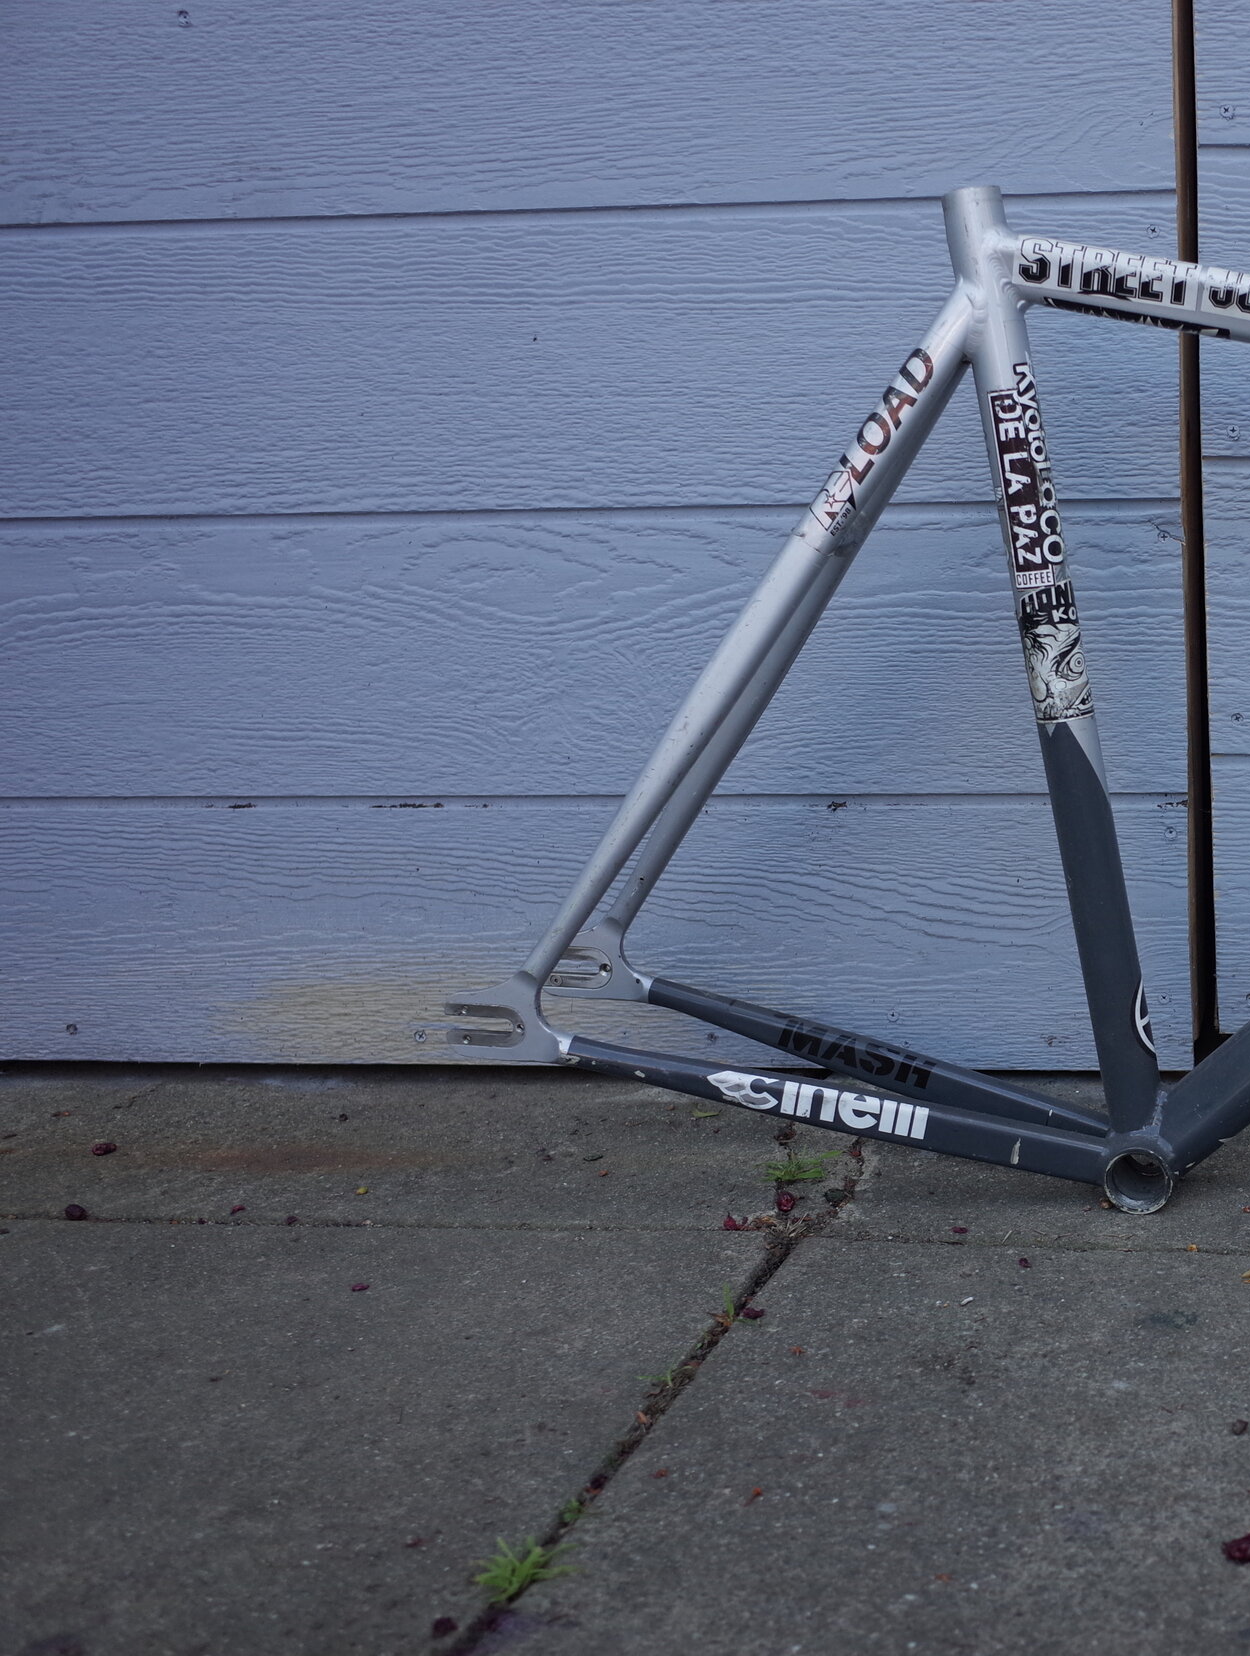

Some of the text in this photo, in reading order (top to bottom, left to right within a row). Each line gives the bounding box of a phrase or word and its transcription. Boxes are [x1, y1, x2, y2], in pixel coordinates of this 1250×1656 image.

[1018, 237, 1197, 306] STREET
[993, 399, 1041, 566] DE LA PAZ
[830, 515, 845, 538] EST.
[1016, 571, 1052, 586] COFFEE
[777, 1017, 938, 1090] MASH
